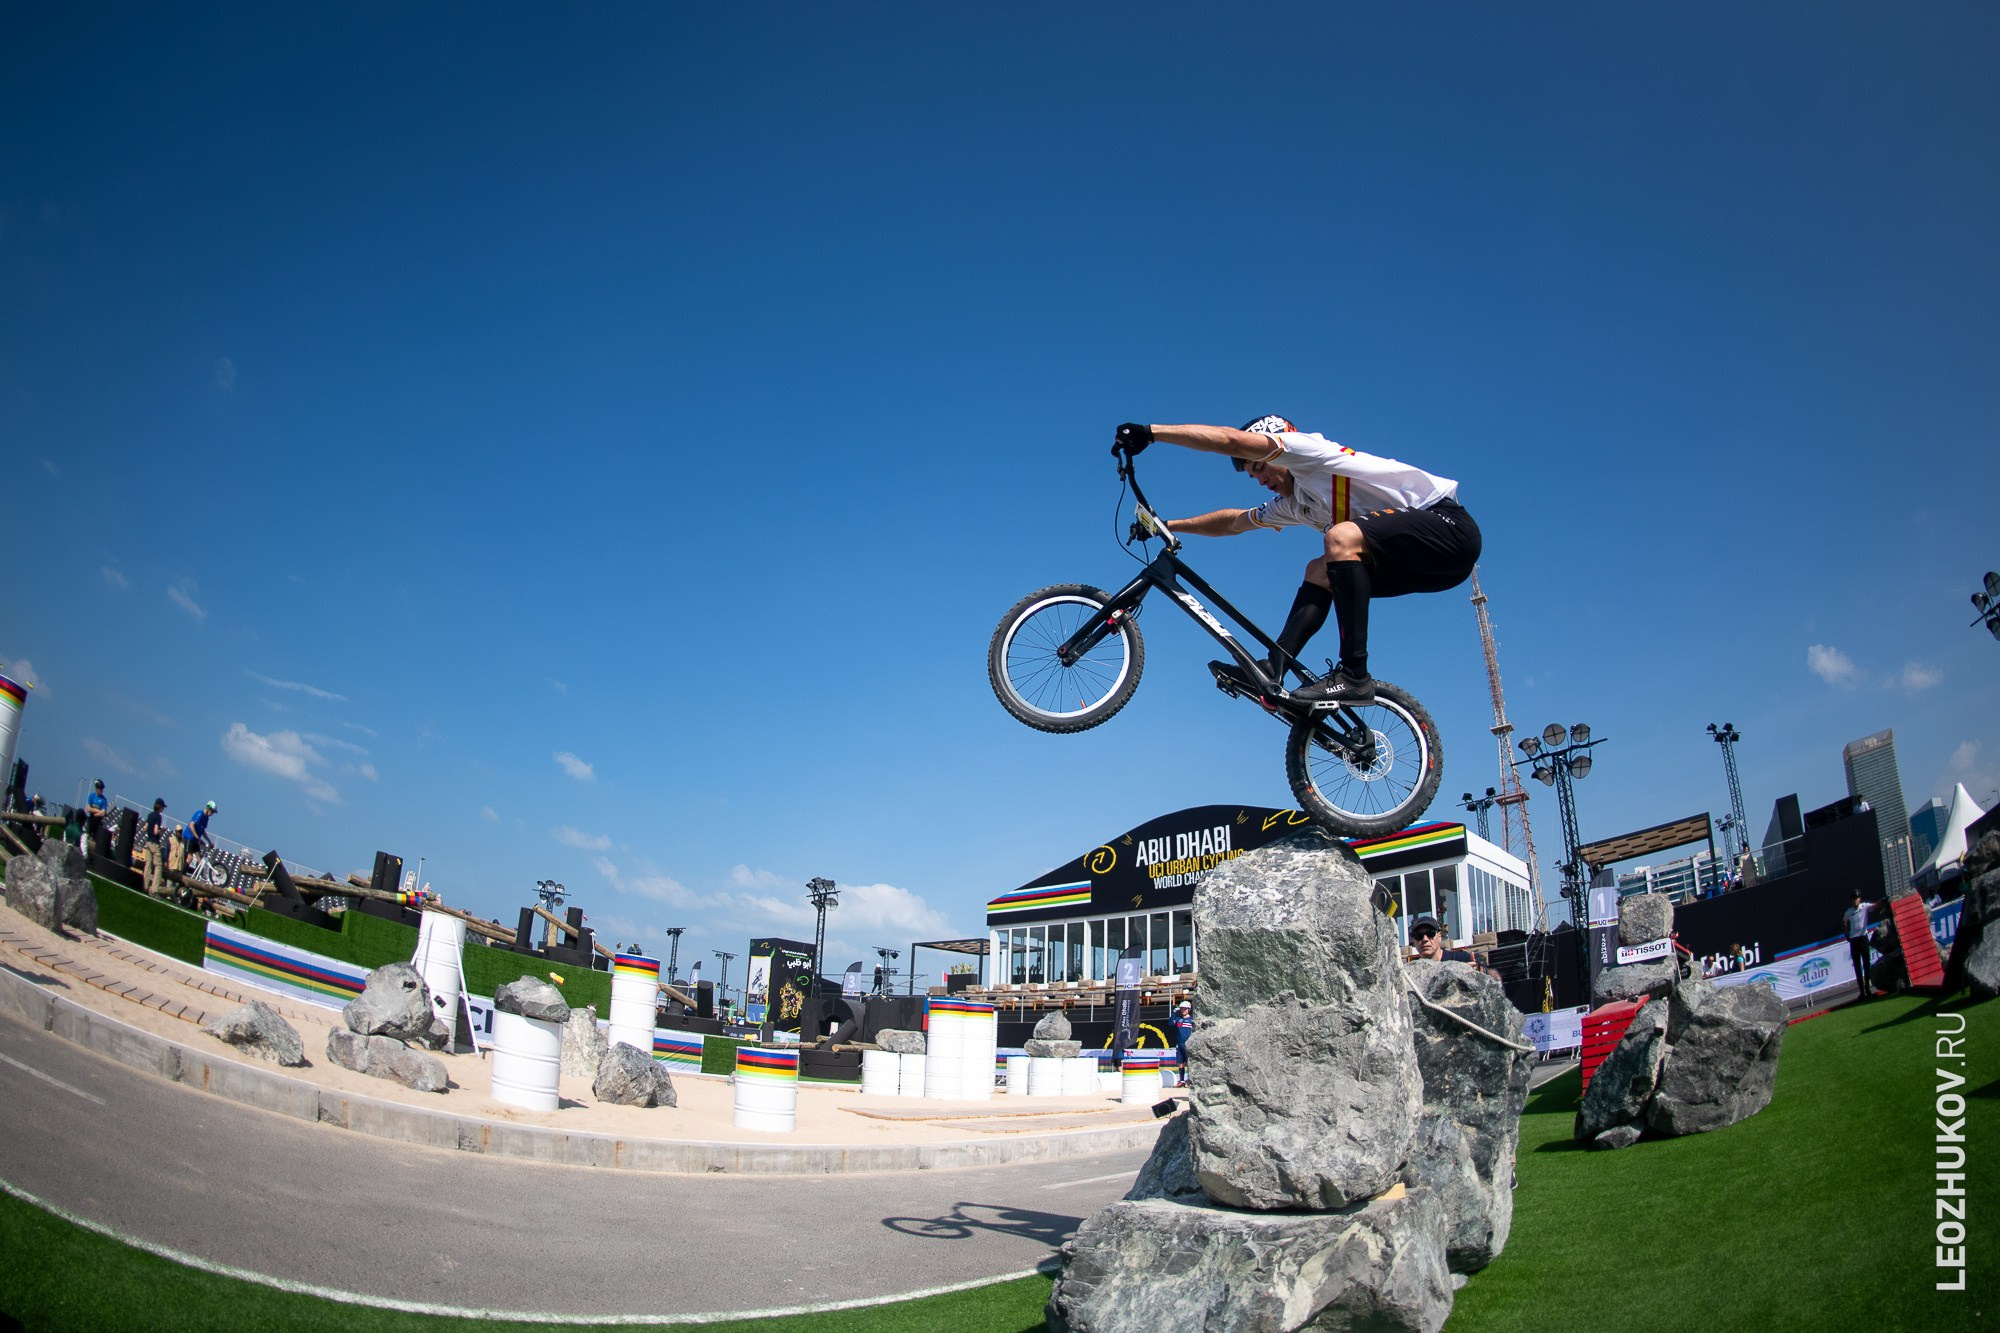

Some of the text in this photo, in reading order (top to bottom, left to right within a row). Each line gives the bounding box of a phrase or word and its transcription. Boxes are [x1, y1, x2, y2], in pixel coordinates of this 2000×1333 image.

[1135, 824, 1231, 868] ABU DHABI
[1149, 862, 1164, 879] UCI
[1166, 856, 1200, 876] URBAN
[1154, 874, 1181, 890] WORLD
[1597, 892, 1606, 914] 1
[1635, 942, 1667, 955] TISSOT
[1123, 962, 1134, 980] 2
[1800, 966, 1829, 984] al ain
[848, 974, 856, 989] 3
[470, 1005, 494, 1034] CI
